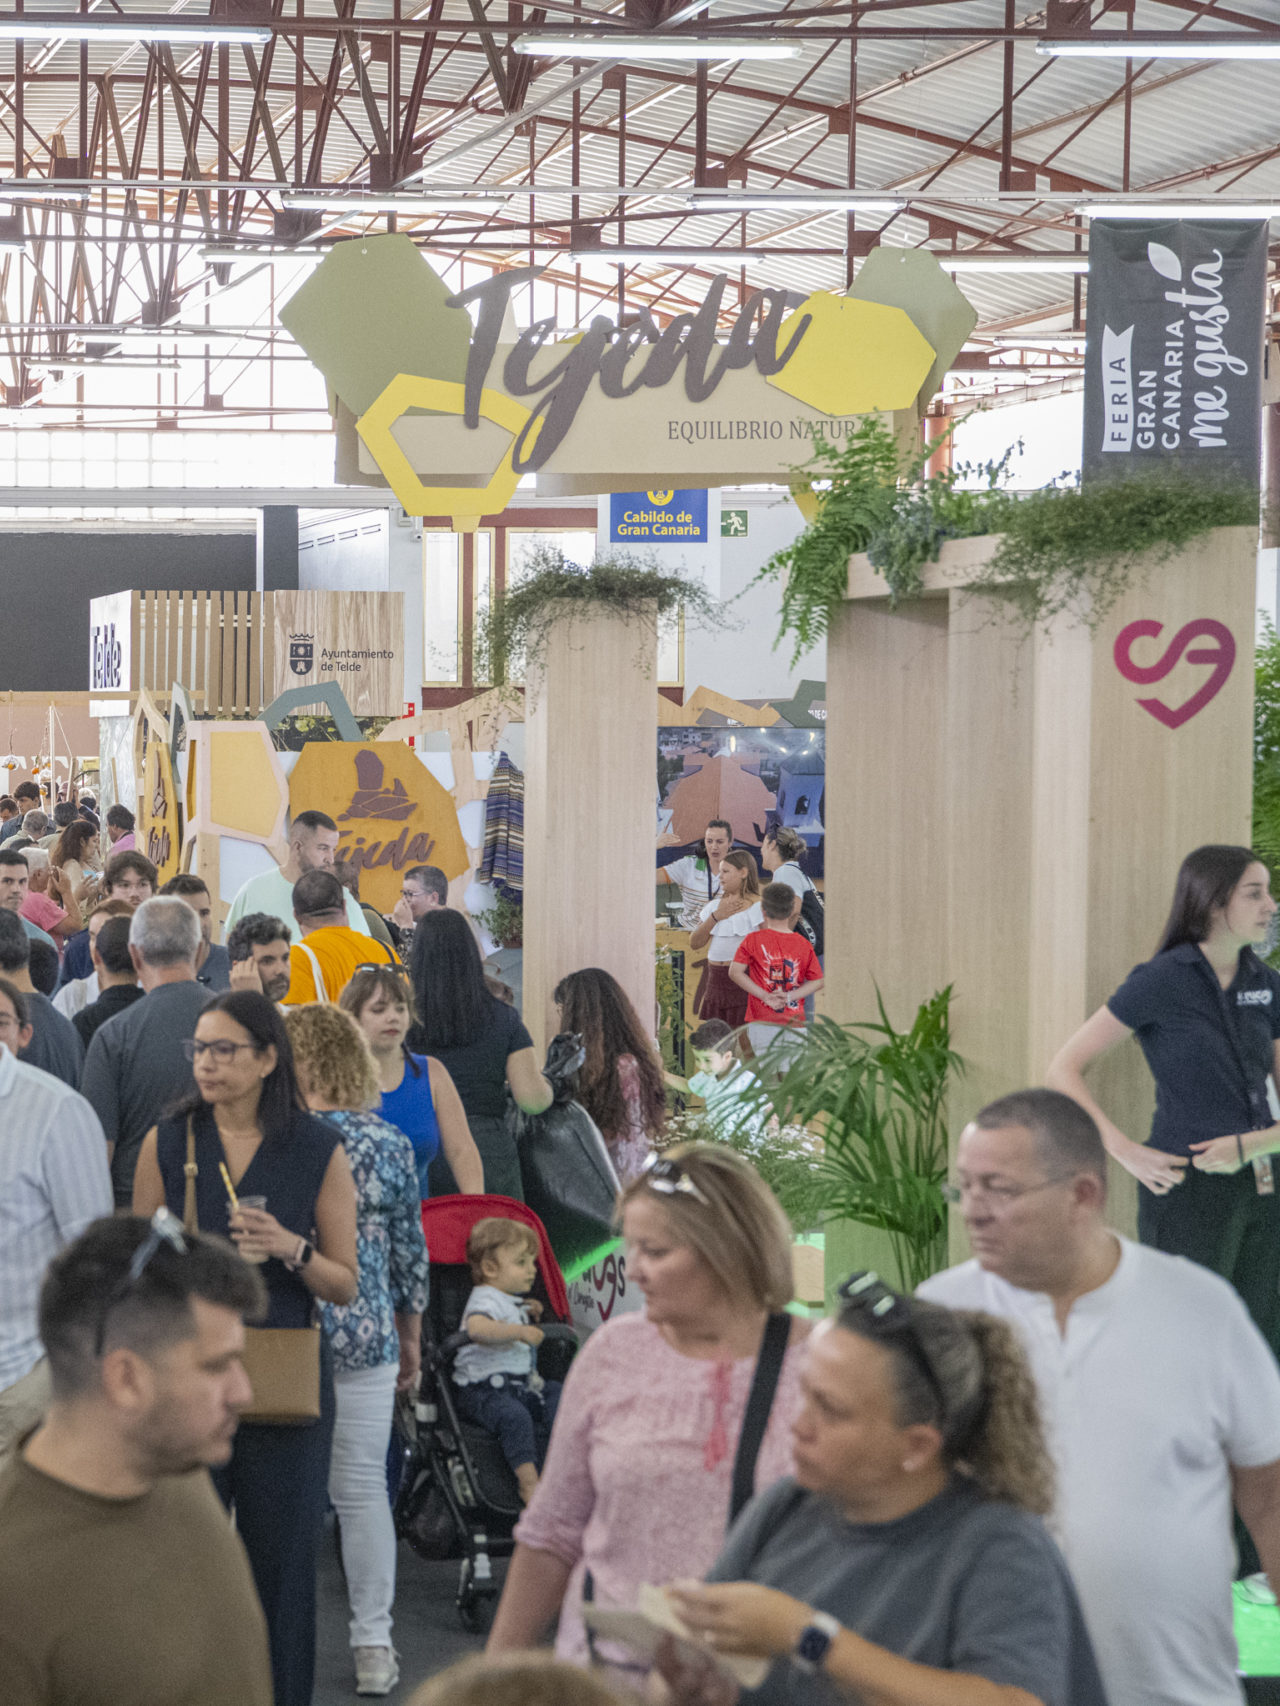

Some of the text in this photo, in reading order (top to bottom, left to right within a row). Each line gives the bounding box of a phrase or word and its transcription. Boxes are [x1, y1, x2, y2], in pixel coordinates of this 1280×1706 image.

[445, 265, 812, 474] Tejeda
[1165, 248, 1248, 448] me gusta
[1109, 357, 1129, 442] FERIA
[1162, 319, 1185, 449] CANARIA
[668, 421, 783, 444] EQUILIBRIO
[1136, 371, 1157, 449] GRAN
[617, 523, 700, 536] Gran Canaria
[623, 510, 693, 523] Cabildo de
[321, 648, 395, 660] Ayuntamiento
[321, 661, 362, 672] de Telde
